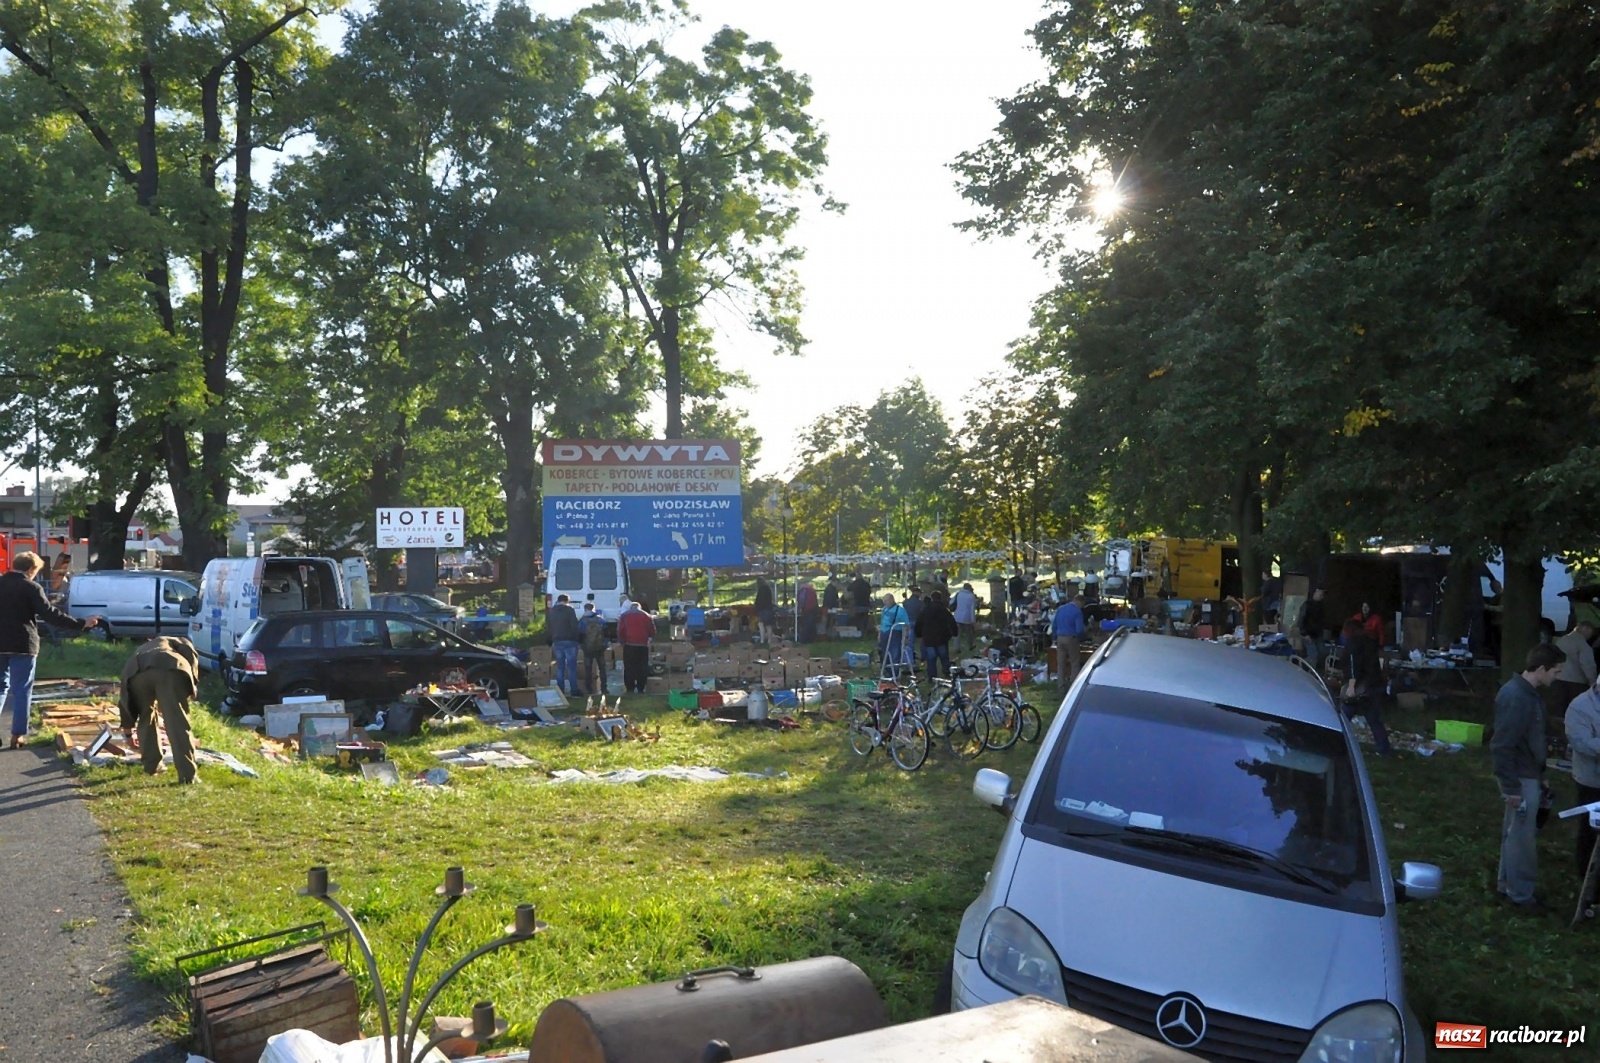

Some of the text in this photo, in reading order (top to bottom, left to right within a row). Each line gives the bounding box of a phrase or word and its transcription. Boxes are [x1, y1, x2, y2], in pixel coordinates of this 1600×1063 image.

[553, 444, 731, 461] DYWYTA
[549, 468, 600, 480] KOBERCE
[657, 468, 707, 480] KOBERCE
[713, 468, 734, 479] PCV
[565, 482, 604, 493] TAPETY
[685, 482, 720, 493] DESKY
[555, 498, 621, 510] RACIBÓRZ
[652, 500, 730, 510] WODZISŁAW
[380, 510, 460, 526] HOTEL
[593, 533, 629, 546] 22 km
[692, 533, 726, 545] 17 km
